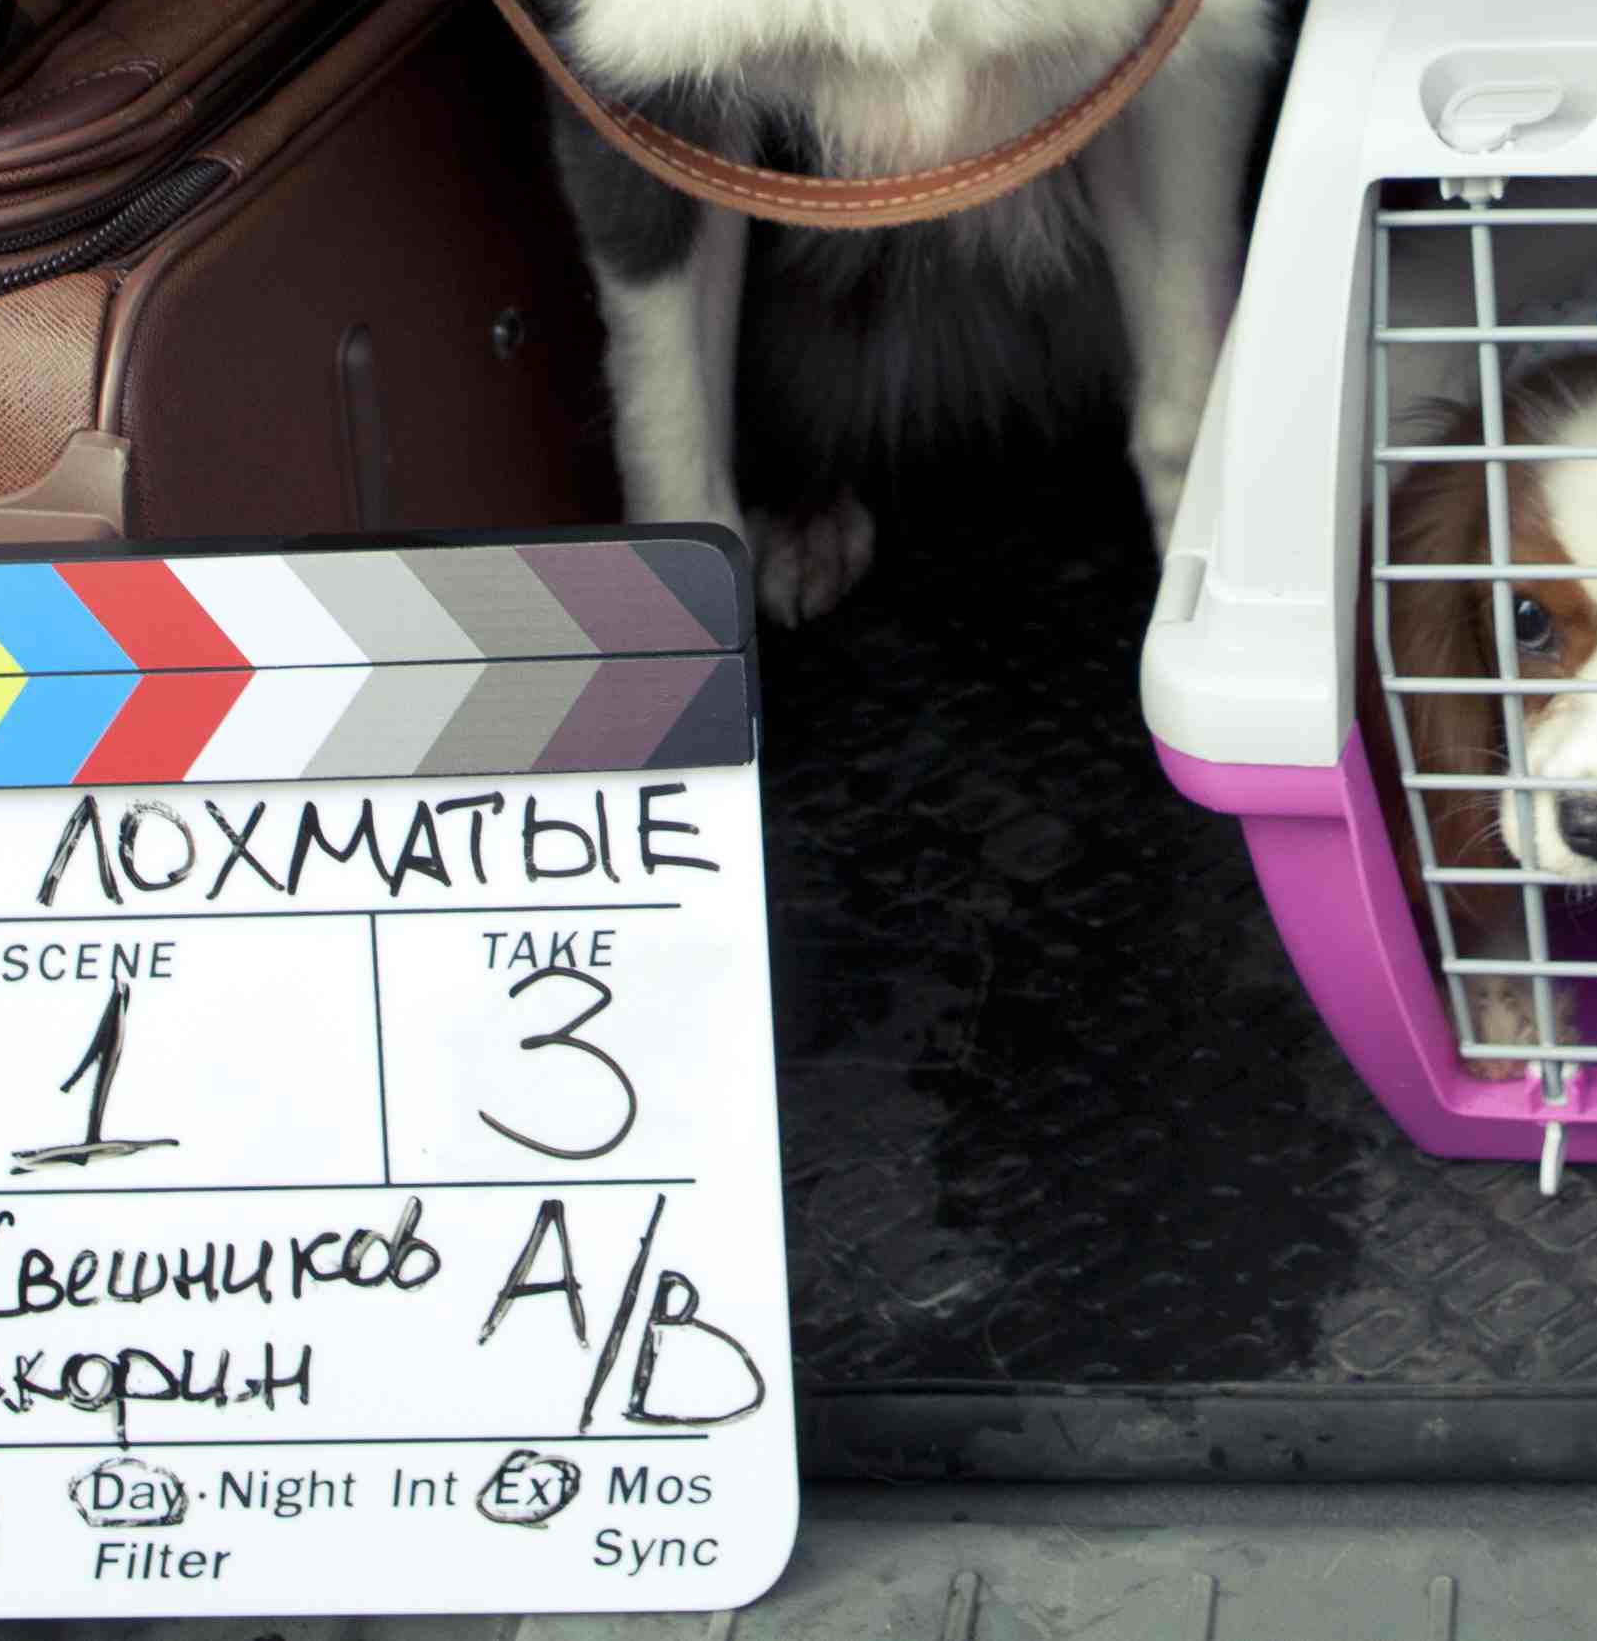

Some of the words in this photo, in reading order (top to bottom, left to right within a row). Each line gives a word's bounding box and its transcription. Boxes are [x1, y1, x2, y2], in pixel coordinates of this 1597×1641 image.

[35, 783, 720, 906] ЛОХМАТЫЕ
[1, 941, 177, 982] SCENE
[483, 930, 617, 969] TAKE
[10, 977, 180, 1174] 1
[479, 966, 637, 1159] 3
[92, 1471, 185, 1521] Day
[219, 1469, 356, 1519] Night
[392, 1468, 458, 1507] Int
[607, 1466, 713, 1504] Mos
[95, 1541, 232, 1580] Filter
[593, 1527, 719, 1576] Sync
